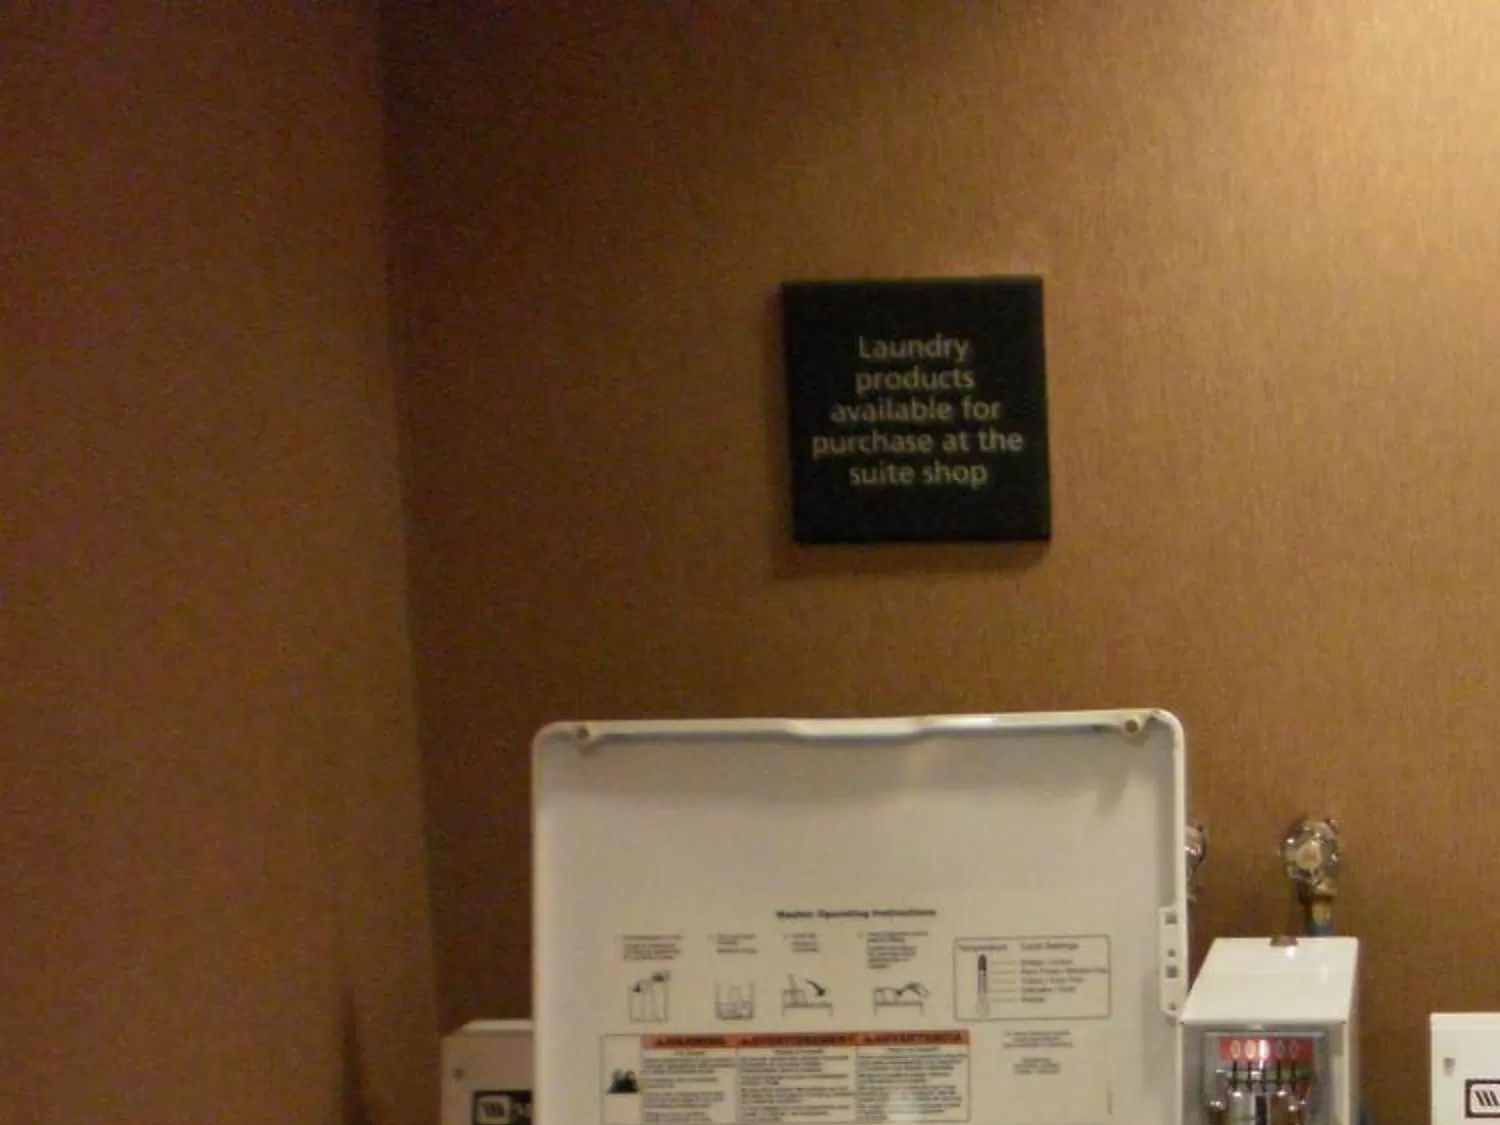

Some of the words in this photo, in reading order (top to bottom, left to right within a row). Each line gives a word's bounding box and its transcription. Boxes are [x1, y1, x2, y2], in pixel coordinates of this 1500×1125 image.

[858, 332, 970, 362] Laundry
[855, 366, 976, 395] products
[830, 396, 954, 423] available
[961, 396, 1003, 422] for
[811, 429, 934, 461] purchase
[942, 431, 969, 453] at
[979, 427, 1024, 453] the
[849, 462, 915, 487] suite
[922, 460, 989, 490] shop
